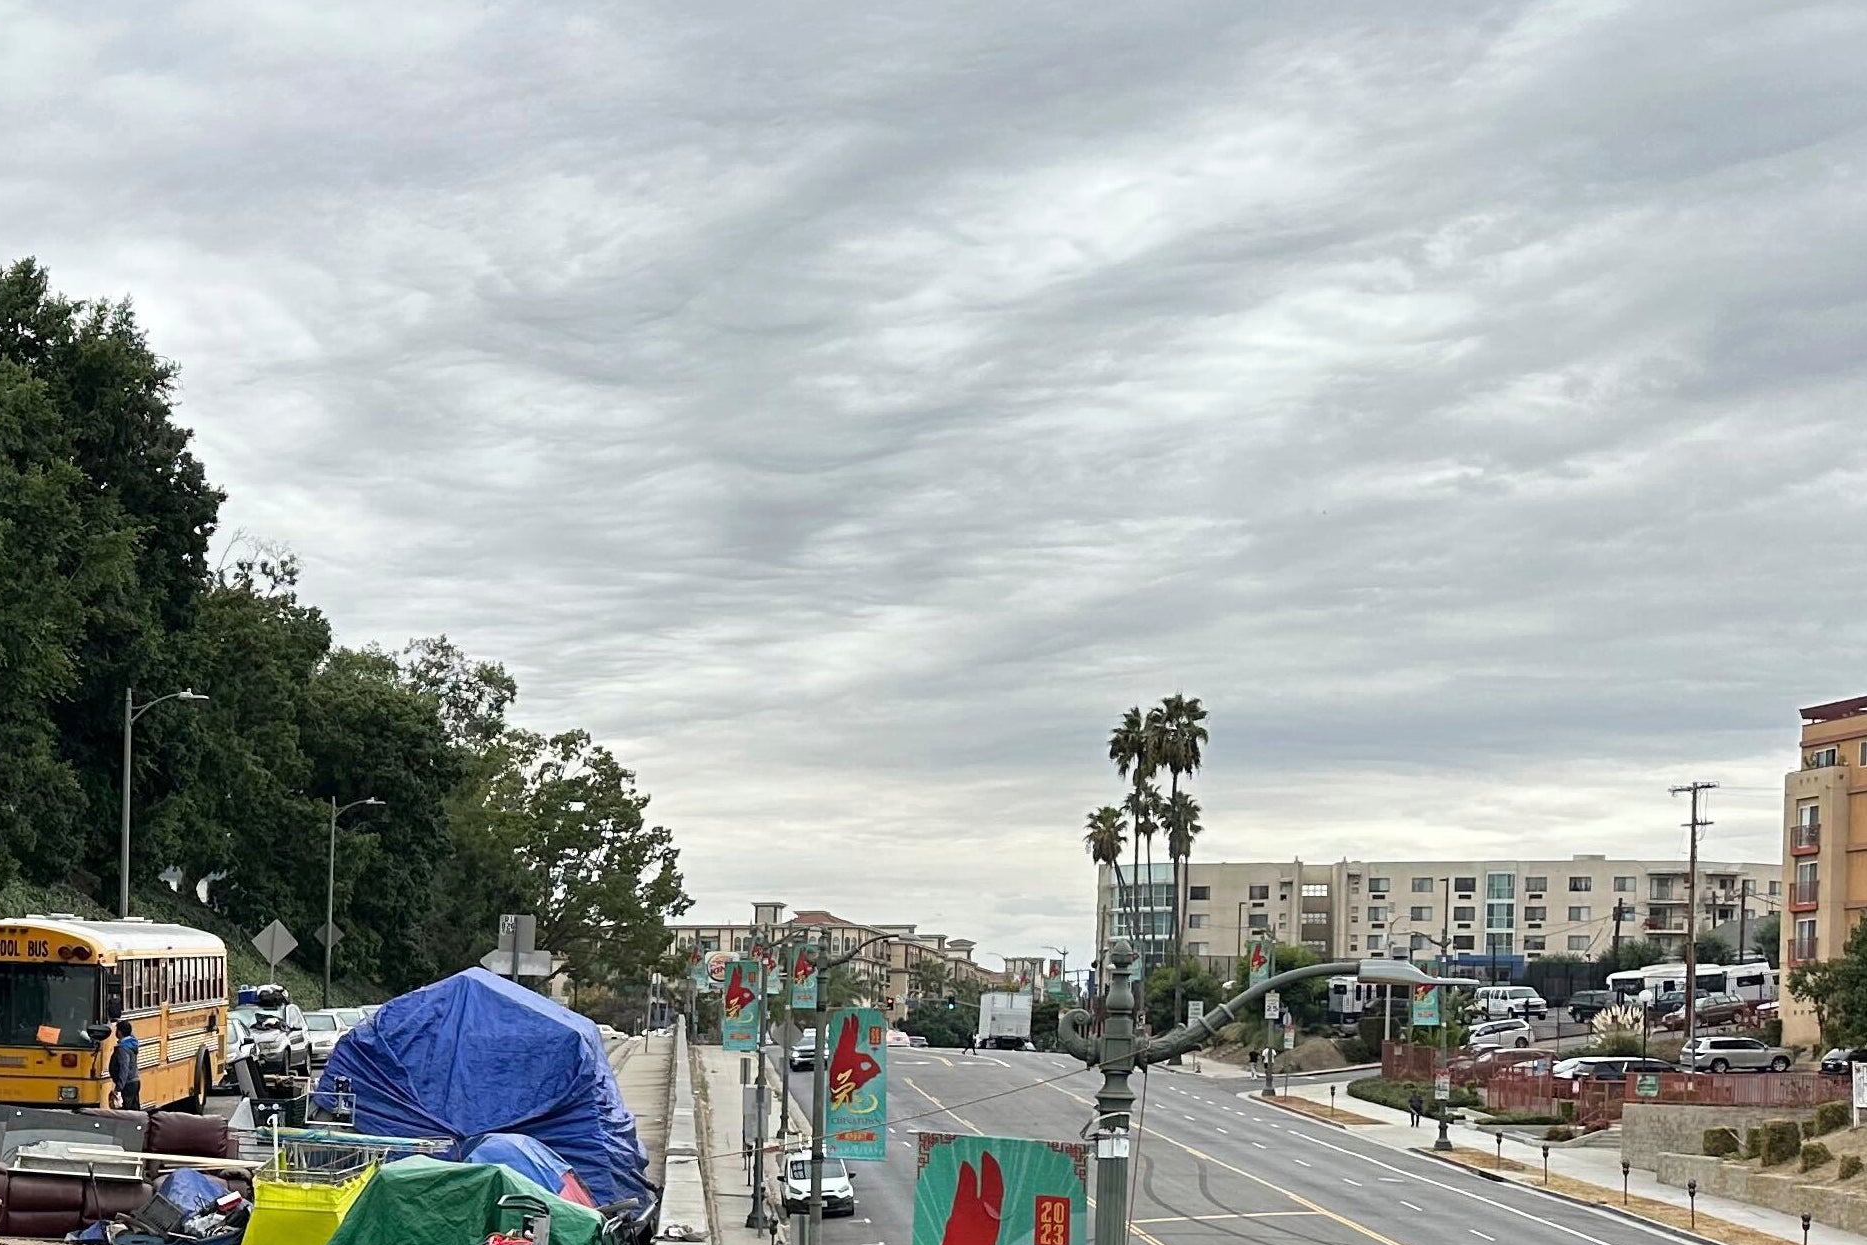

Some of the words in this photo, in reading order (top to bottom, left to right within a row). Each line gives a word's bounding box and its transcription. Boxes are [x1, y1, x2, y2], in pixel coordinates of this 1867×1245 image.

[27, 940, 49, 957] BUS
[1041, 1201, 1065, 1224] 20
[1040, 1223, 1064, 1245] 23
